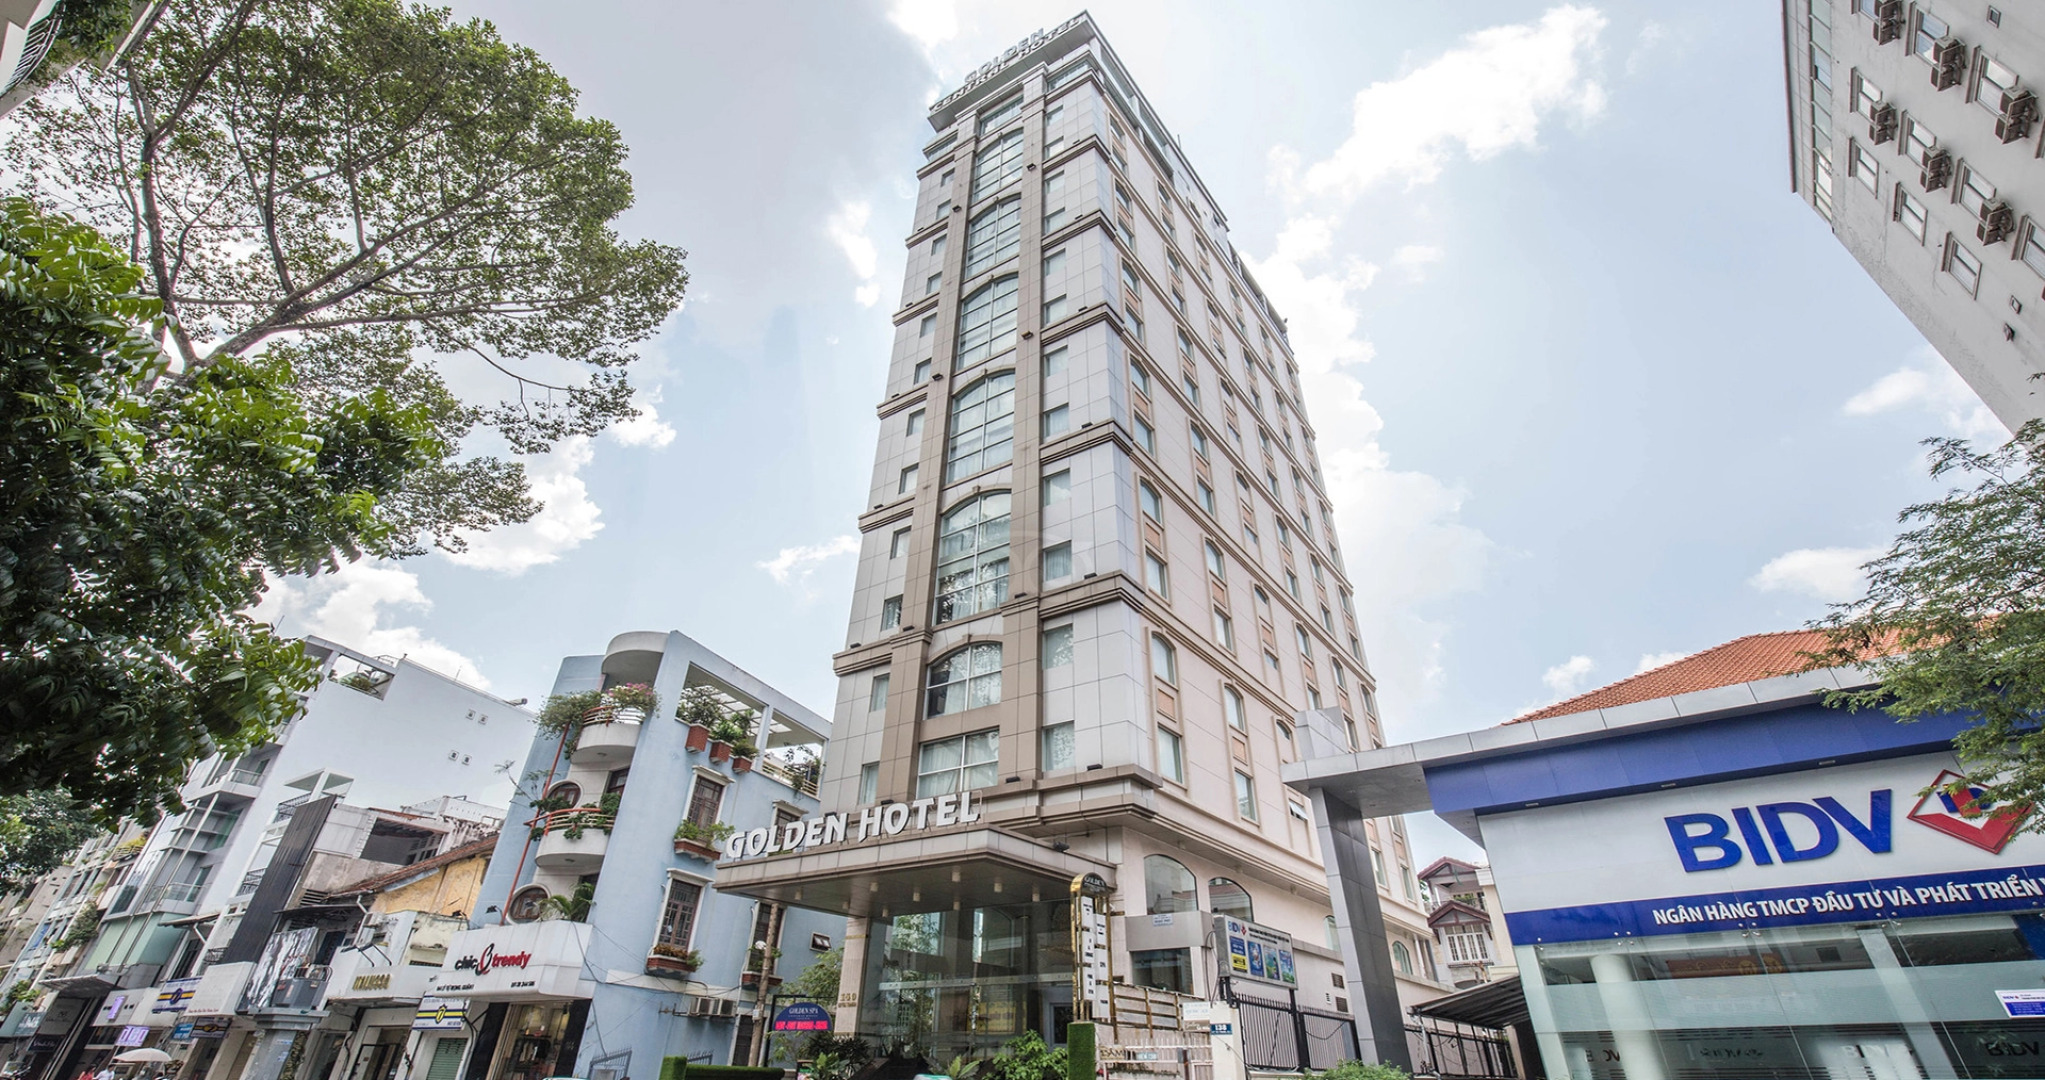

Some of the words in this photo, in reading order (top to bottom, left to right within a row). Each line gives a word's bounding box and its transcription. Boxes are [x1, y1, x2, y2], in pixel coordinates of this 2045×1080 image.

[933, 62, 1011, 112] CENTRAL
[1018, 16, 1082, 59] HOTEL
[964, 28, 1045, 84] GOLDEN
[726, 812, 849, 859] GOLDEN
[857, 791, 980, 842] HOTEL
[1663, 788, 1893, 873] BIDV
[1652, 904, 1704, 926] NGÂN
[1703, 901, 1759, 921] HÀNG
[1756, 898, 1810, 917] TMCP
[1812, 890, 1855, 913] ĐẦU
[1853, 889, 1885, 910] TƯ
[1882, 886, 1918, 907] VÀ
[1914, 882, 1973, 905] PHÁT
[1971, 874, 2044, 901] TRIỂN
[491, 951, 532, 969] trendy
